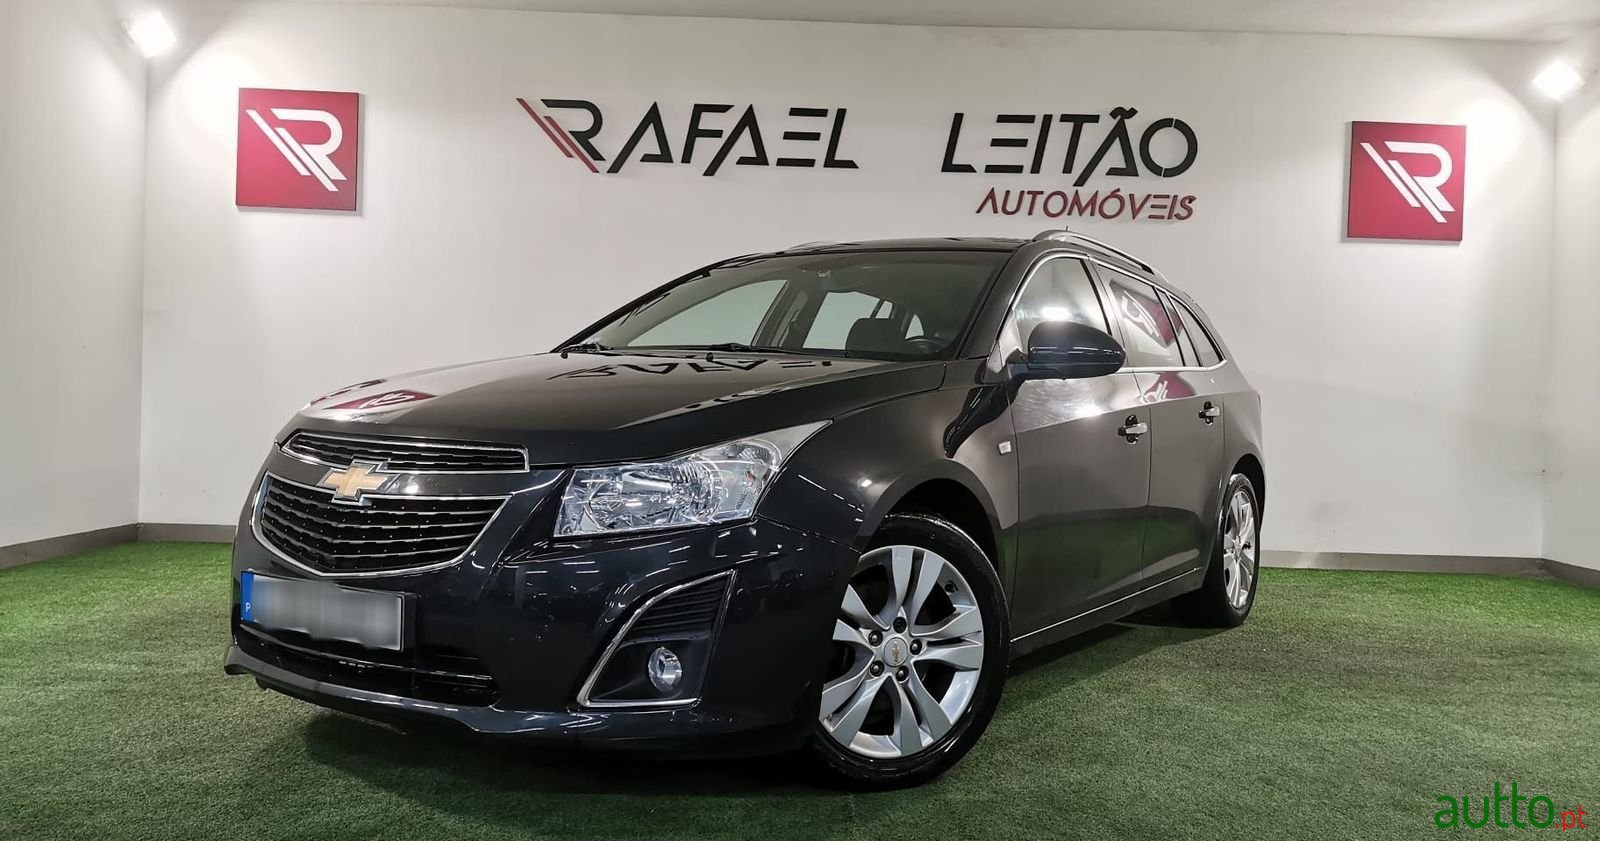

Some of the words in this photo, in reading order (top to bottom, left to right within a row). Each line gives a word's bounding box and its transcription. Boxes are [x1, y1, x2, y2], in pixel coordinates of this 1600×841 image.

[516, 98, 860, 177] RAFAEL
[941, 106, 1199, 188] LEITÃO
[975, 187, 1197, 220] AUTOMÓVEIS
[245, 602, 251, 612] P
